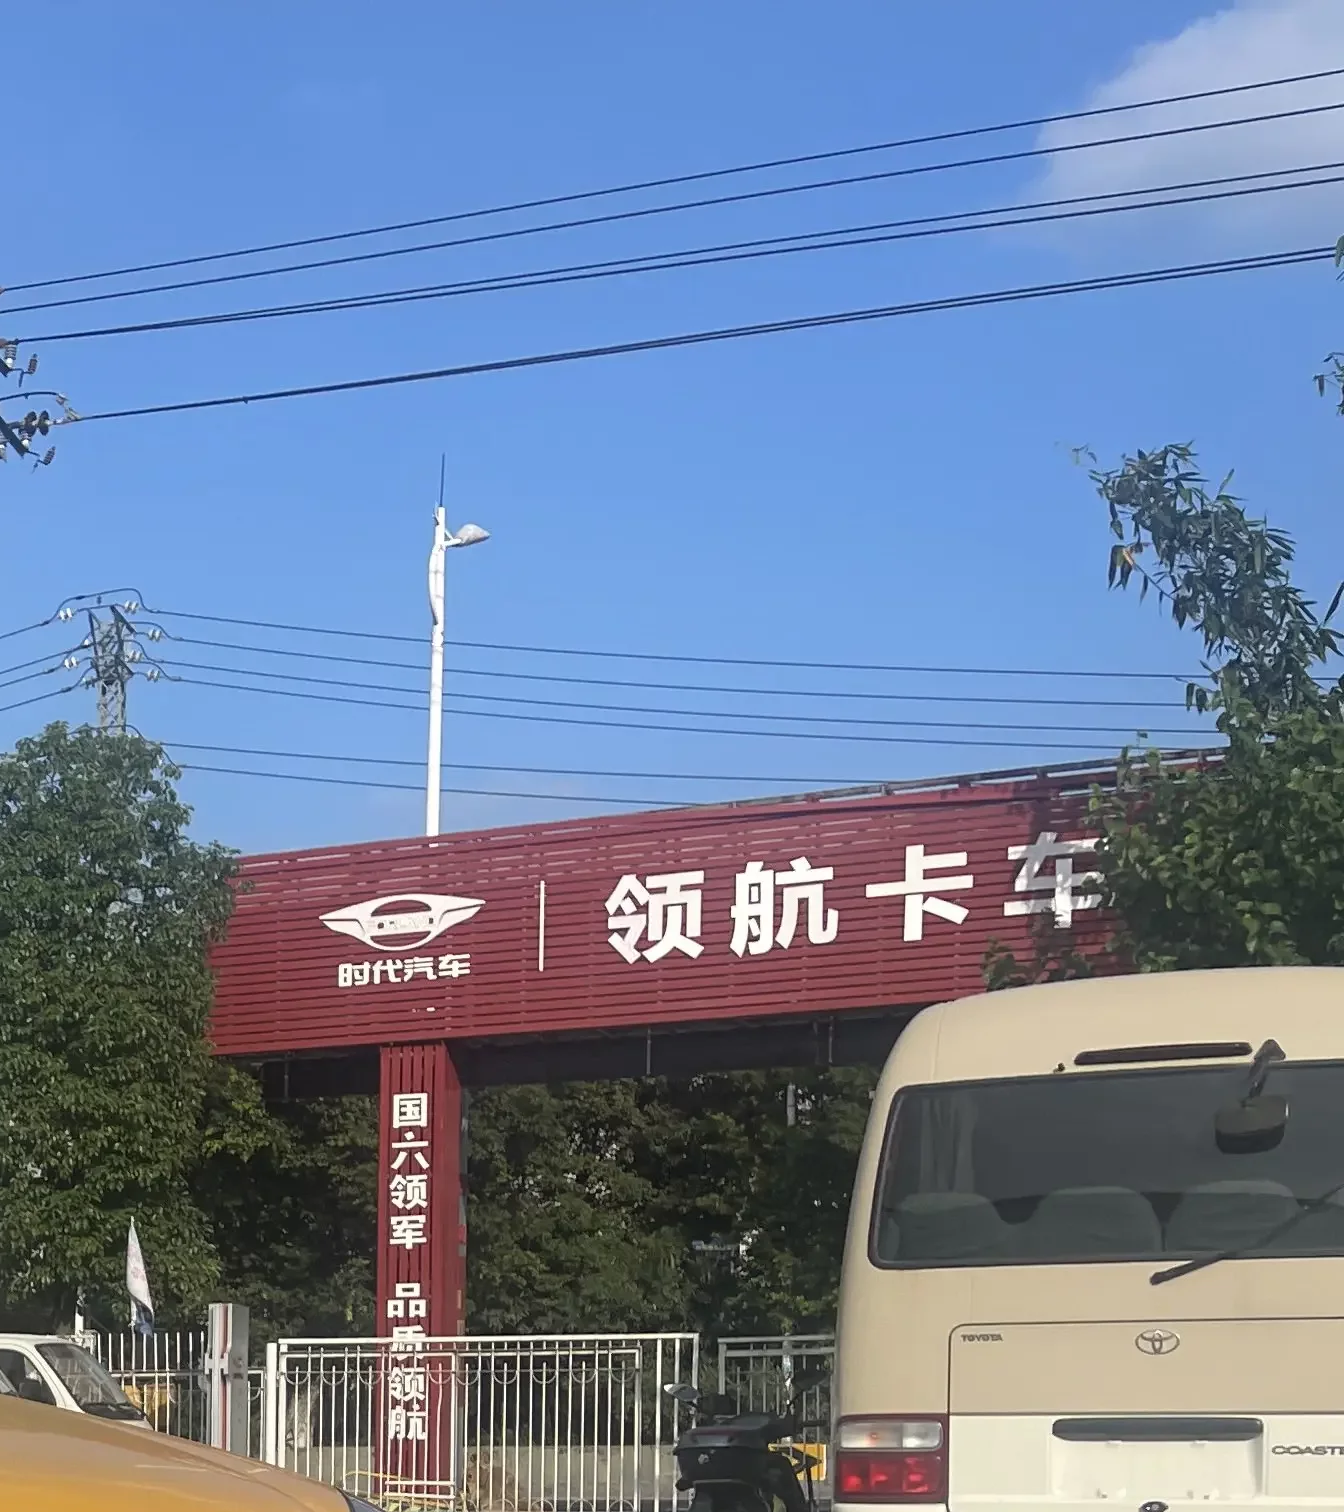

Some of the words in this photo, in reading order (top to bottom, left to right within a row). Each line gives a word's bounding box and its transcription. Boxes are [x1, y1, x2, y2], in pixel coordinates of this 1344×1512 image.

[604, 831, 1111, 965] 领航卡车
[338, 953, 471, 988] 时代汽车
[389, 1092, 430, 1250] 国六领军
[386, 1282, 428, 1441] 品质领航
[961, 1333, 1004, 1342] TOYOTA
